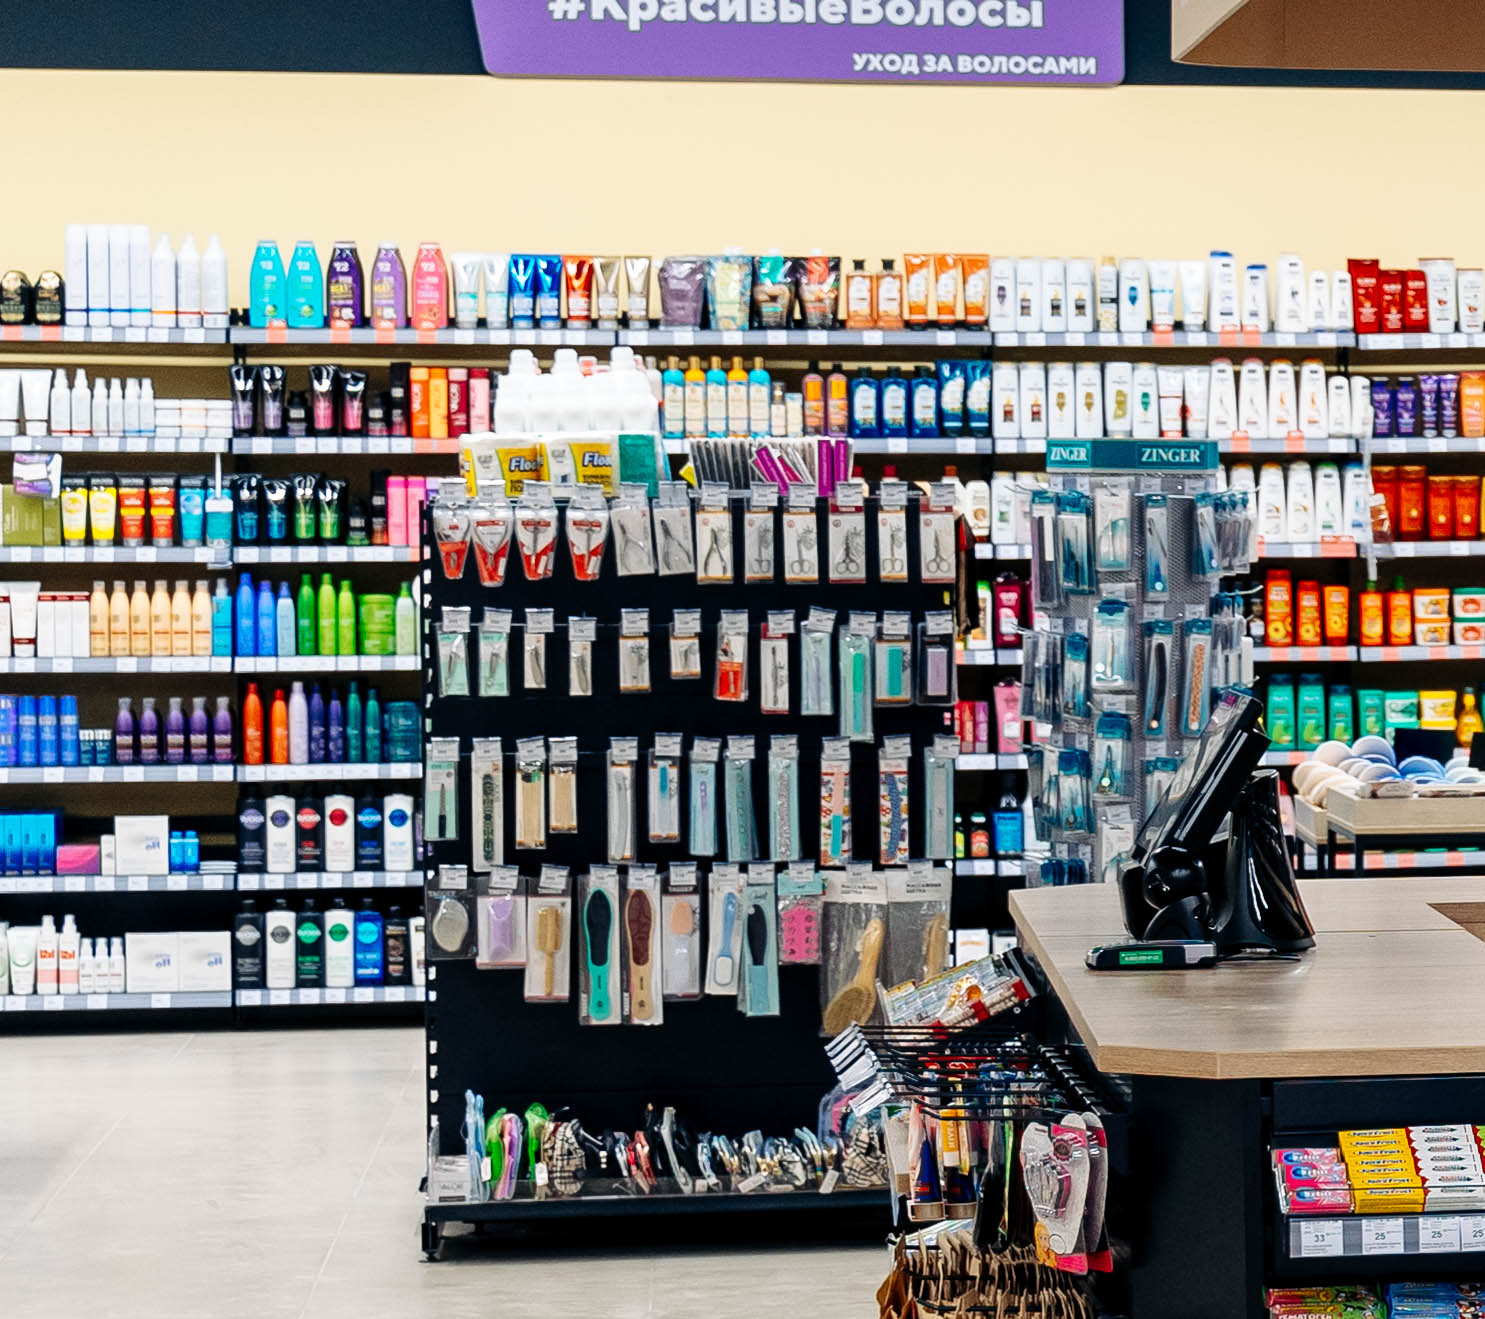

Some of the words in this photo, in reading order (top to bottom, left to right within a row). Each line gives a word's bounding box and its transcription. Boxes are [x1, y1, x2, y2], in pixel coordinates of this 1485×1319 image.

[852, 52, 918, 74] УХОД
[922, 54, 953, 72] ЗА
[957, 54, 1097, 75] ВОЛОСАМИ
[1051, 447, 1087, 461] ZINGER
[1141, 448, 1200, 462] ZINGER
